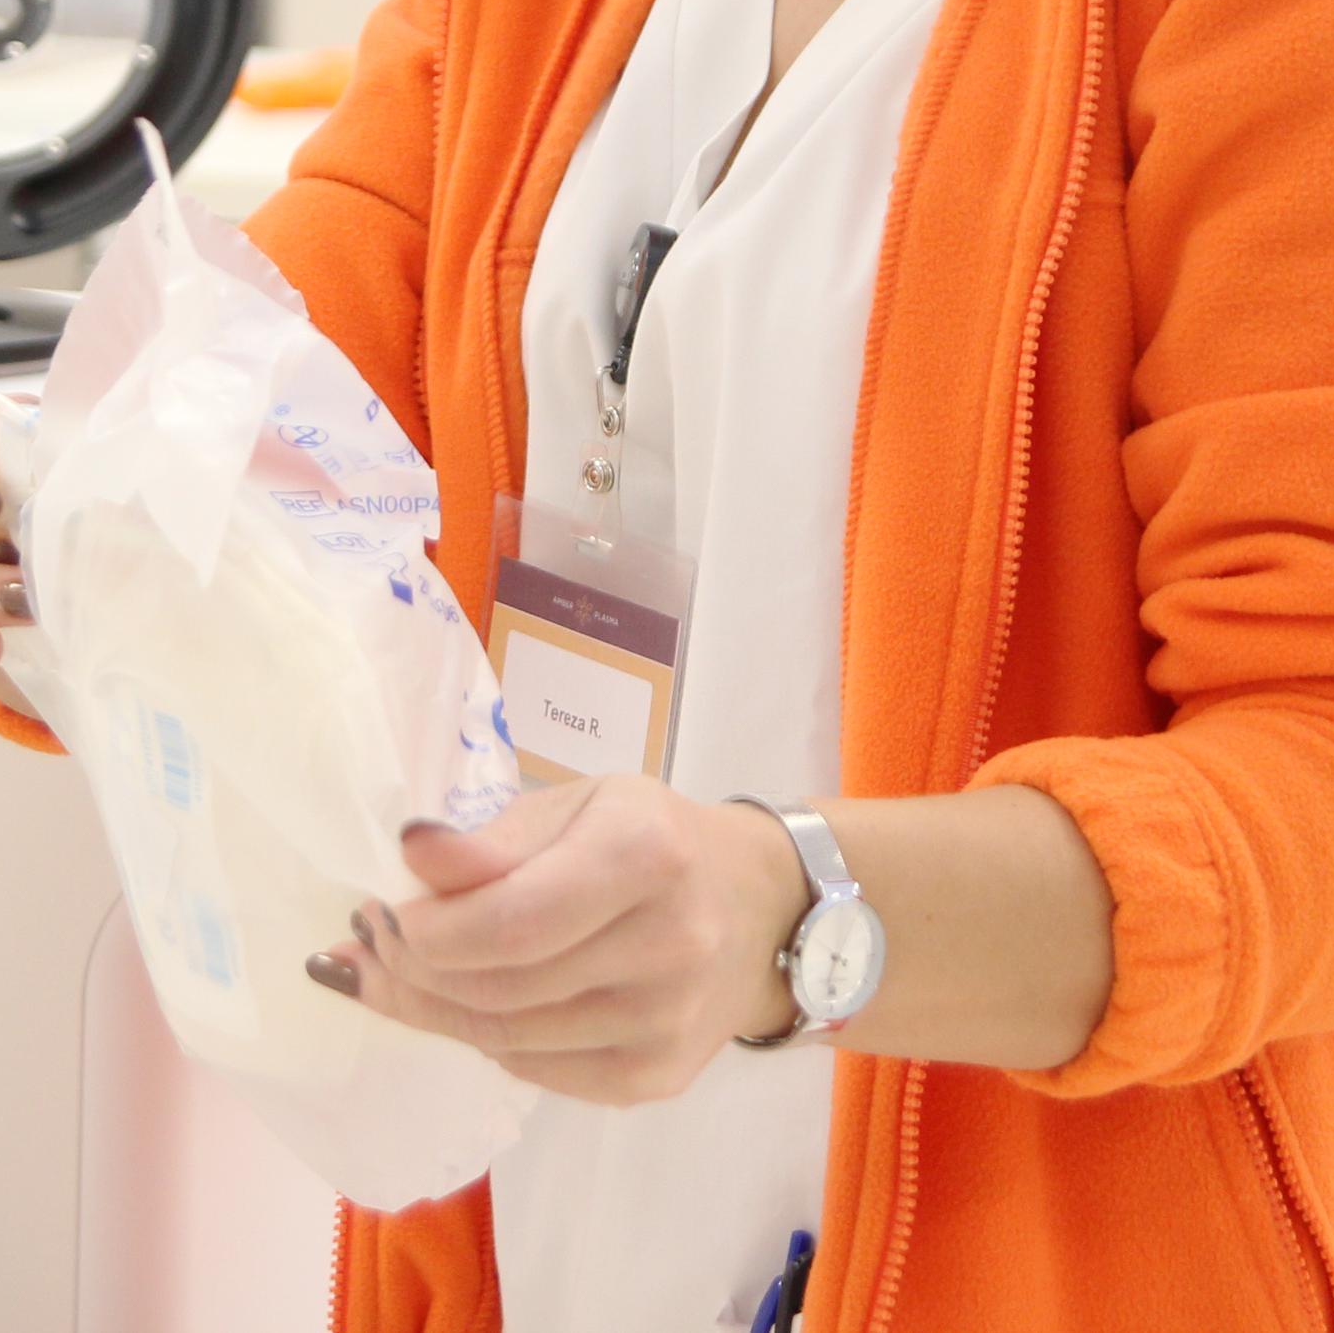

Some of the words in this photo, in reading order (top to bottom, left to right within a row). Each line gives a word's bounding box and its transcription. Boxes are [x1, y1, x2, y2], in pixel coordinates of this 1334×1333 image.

[280, 498, 323, 513] REF
[544, 698, 586, 732] Tereza
[589, 716, 602, 740] R.
